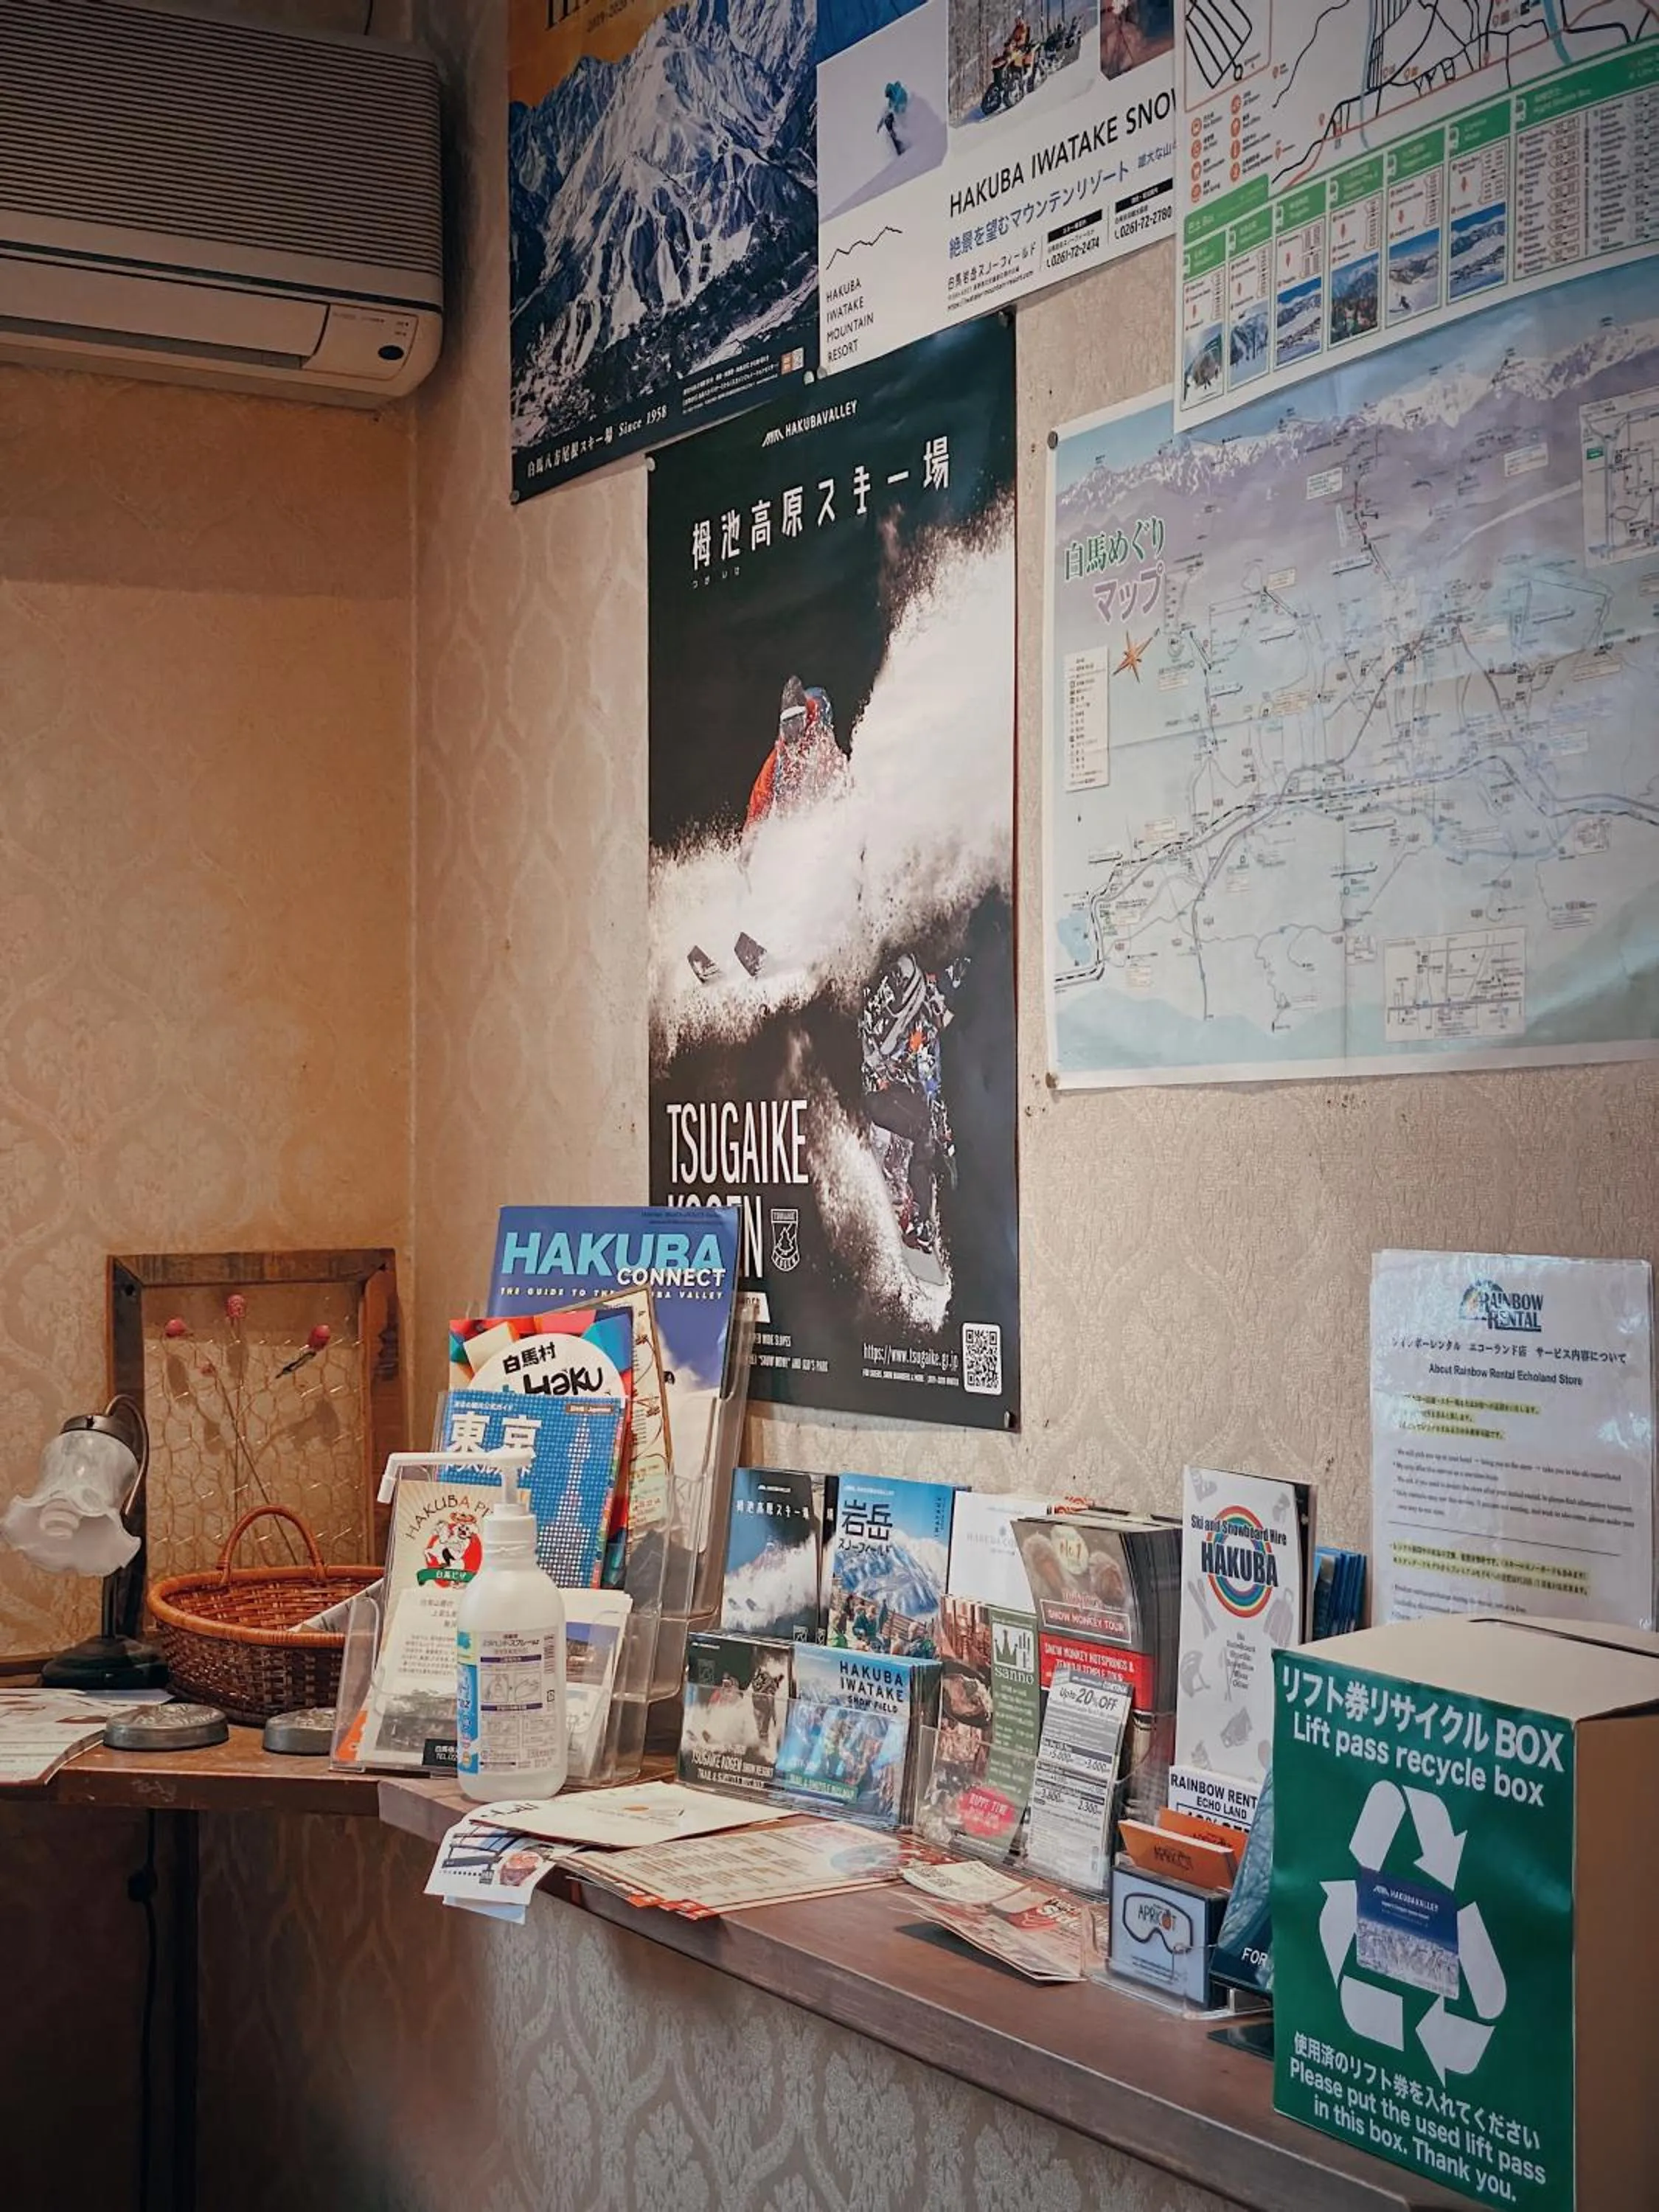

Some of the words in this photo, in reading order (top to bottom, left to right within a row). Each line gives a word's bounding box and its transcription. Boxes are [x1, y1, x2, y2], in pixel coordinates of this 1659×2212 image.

[950, 162, 1024, 218] HAKUBA
[1032, 116, 1119, 178] IWATAKE
[826, 277, 862, 303] HAKUBA
[827, 296, 863, 323] IWATAKE
[827, 312, 874, 343] MOUNTAIN
[827, 339, 858, 363] RESORT
[618, 419, 642, 437] Since
[645, 404, 667, 425] 1958
[785, 399, 858, 438] HAKUBAVALLEY
[692, 435, 950, 571] 栂池高原スキー場
[1065, 516, 1165, 581] 白馬めぐり
[1093, 563, 1166, 623] マップ
[667, 1099, 809, 1184] TSUGAIKE
[501, 1231, 723, 1276] HAKUBA
[527, 1288, 563, 1296] GUIDE
[572, 1289, 586, 1297] TO
[680, 1291, 723, 1299] VALLEY
[617, 1268, 726, 1287] CONNECT
[1480, 1291, 1544, 1312] RAINBOW
[503, 1341, 556, 1374] 白馬村
[1428, 1363, 1452, 1375] About
[1453, 1365, 1487, 1378] Rainbow
[1489, 1368, 1515, 1380] Rental
[1517, 1370, 1557, 1384] Echoland
[1559, 1373, 1583, 1386] Store
[448, 1411, 543, 1453] 東京
[405, 1495, 470, 1540] HAKUBA
[841, 1499, 893, 1541] 岩岳
[1191, 1514, 1204, 1528] Ski
[1205, 1517, 1221, 1532] and
[1222, 1520, 1269, 1541] Snowboard
[1270, 1529, 1287, 1545] Hire
[1201, 1541, 1279, 1587] HAKUBA
[1048, 1609, 1070, 1622] SNOW
[1071, 1613, 1102, 1627] MONKEY
[1105, 1620, 1124, 1632] TOUR
[839, 1660, 904, 1686] HAKUBA
[995, 1666, 1034, 1685] sanno
[840, 1677, 904, 1703] IWATAKE
[1099, 1696, 1119, 1711] OFF
[873, 1700, 898, 1714] FIELD
[1293, 1711, 1331, 1749] Lift
[1335, 1727, 1390, 1765] pass
[1396, 1745, 1486, 1791] recycle
[1495, 1765, 1545, 1806] box
[1170, 1773, 1225, 1799] RAINBOW
[1228, 1790, 1258, 1809] RENT
[1196, 1796, 1222, 1812] ECHO
[1223, 1804, 1247, 1819] LAND
[1293, 2031, 1540, 2150] 使用済のリフト券を入れてください
[1289, 2057, 1343, 2098] Please
[1347, 2083, 1377, 2115] put
[1381, 2096, 1411, 2127] the
[1415, 2110, 1461, 2149] used
[1465, 2132, 1493, 2163] lift
[1498, 2149, 1547, 2186] pass
[1313, 2095, 1329, 2121] in
[1332, 2101, 1365, 2136] this
[1369, 2120, 1408, 2157] box.
[1412, 2137, 1470, 2183] Thank
[1474, 2166, 1517, 2202] you.
